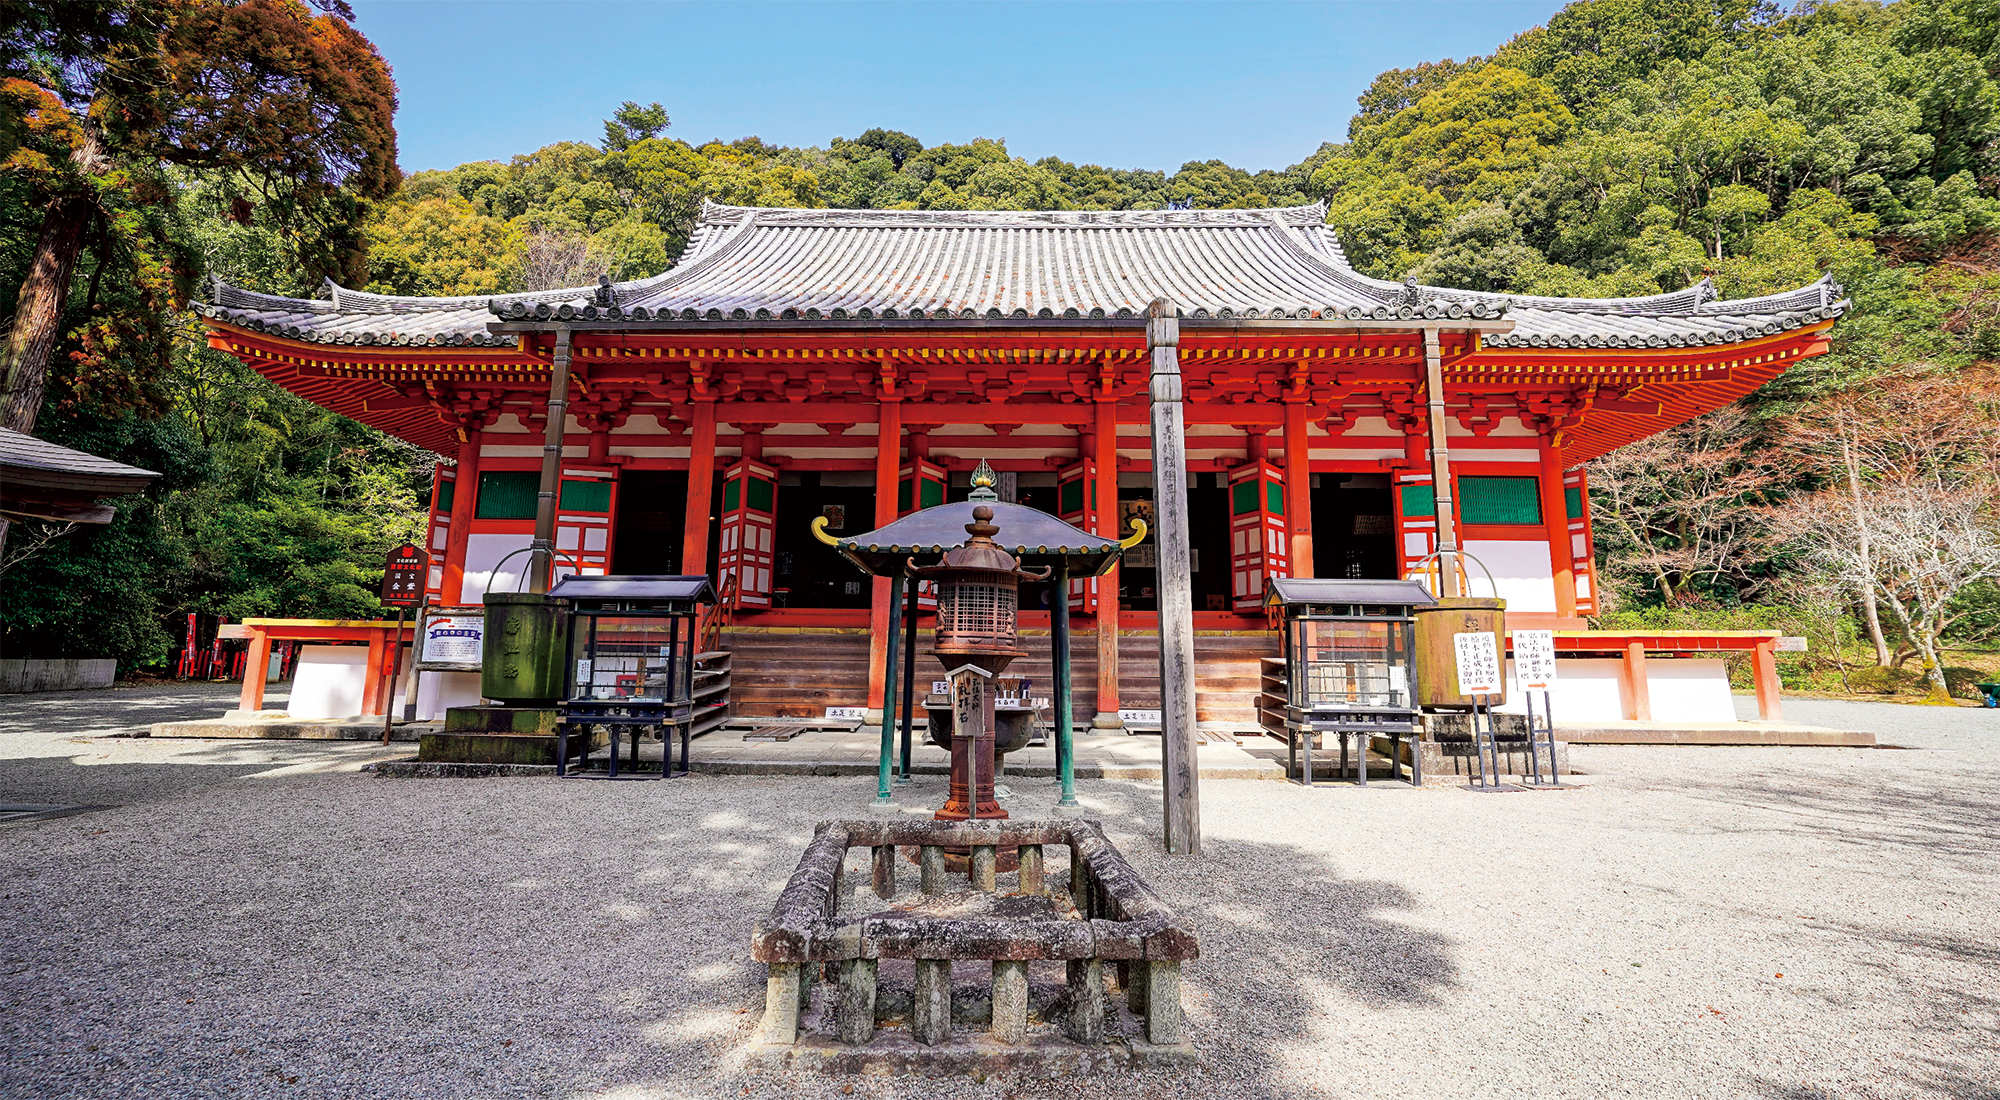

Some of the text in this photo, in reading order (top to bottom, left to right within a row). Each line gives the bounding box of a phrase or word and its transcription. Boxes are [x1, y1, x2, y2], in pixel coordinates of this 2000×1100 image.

[392, 582, 416, 590] 金堂
[958, 682, 971, 723] 礼拝石
